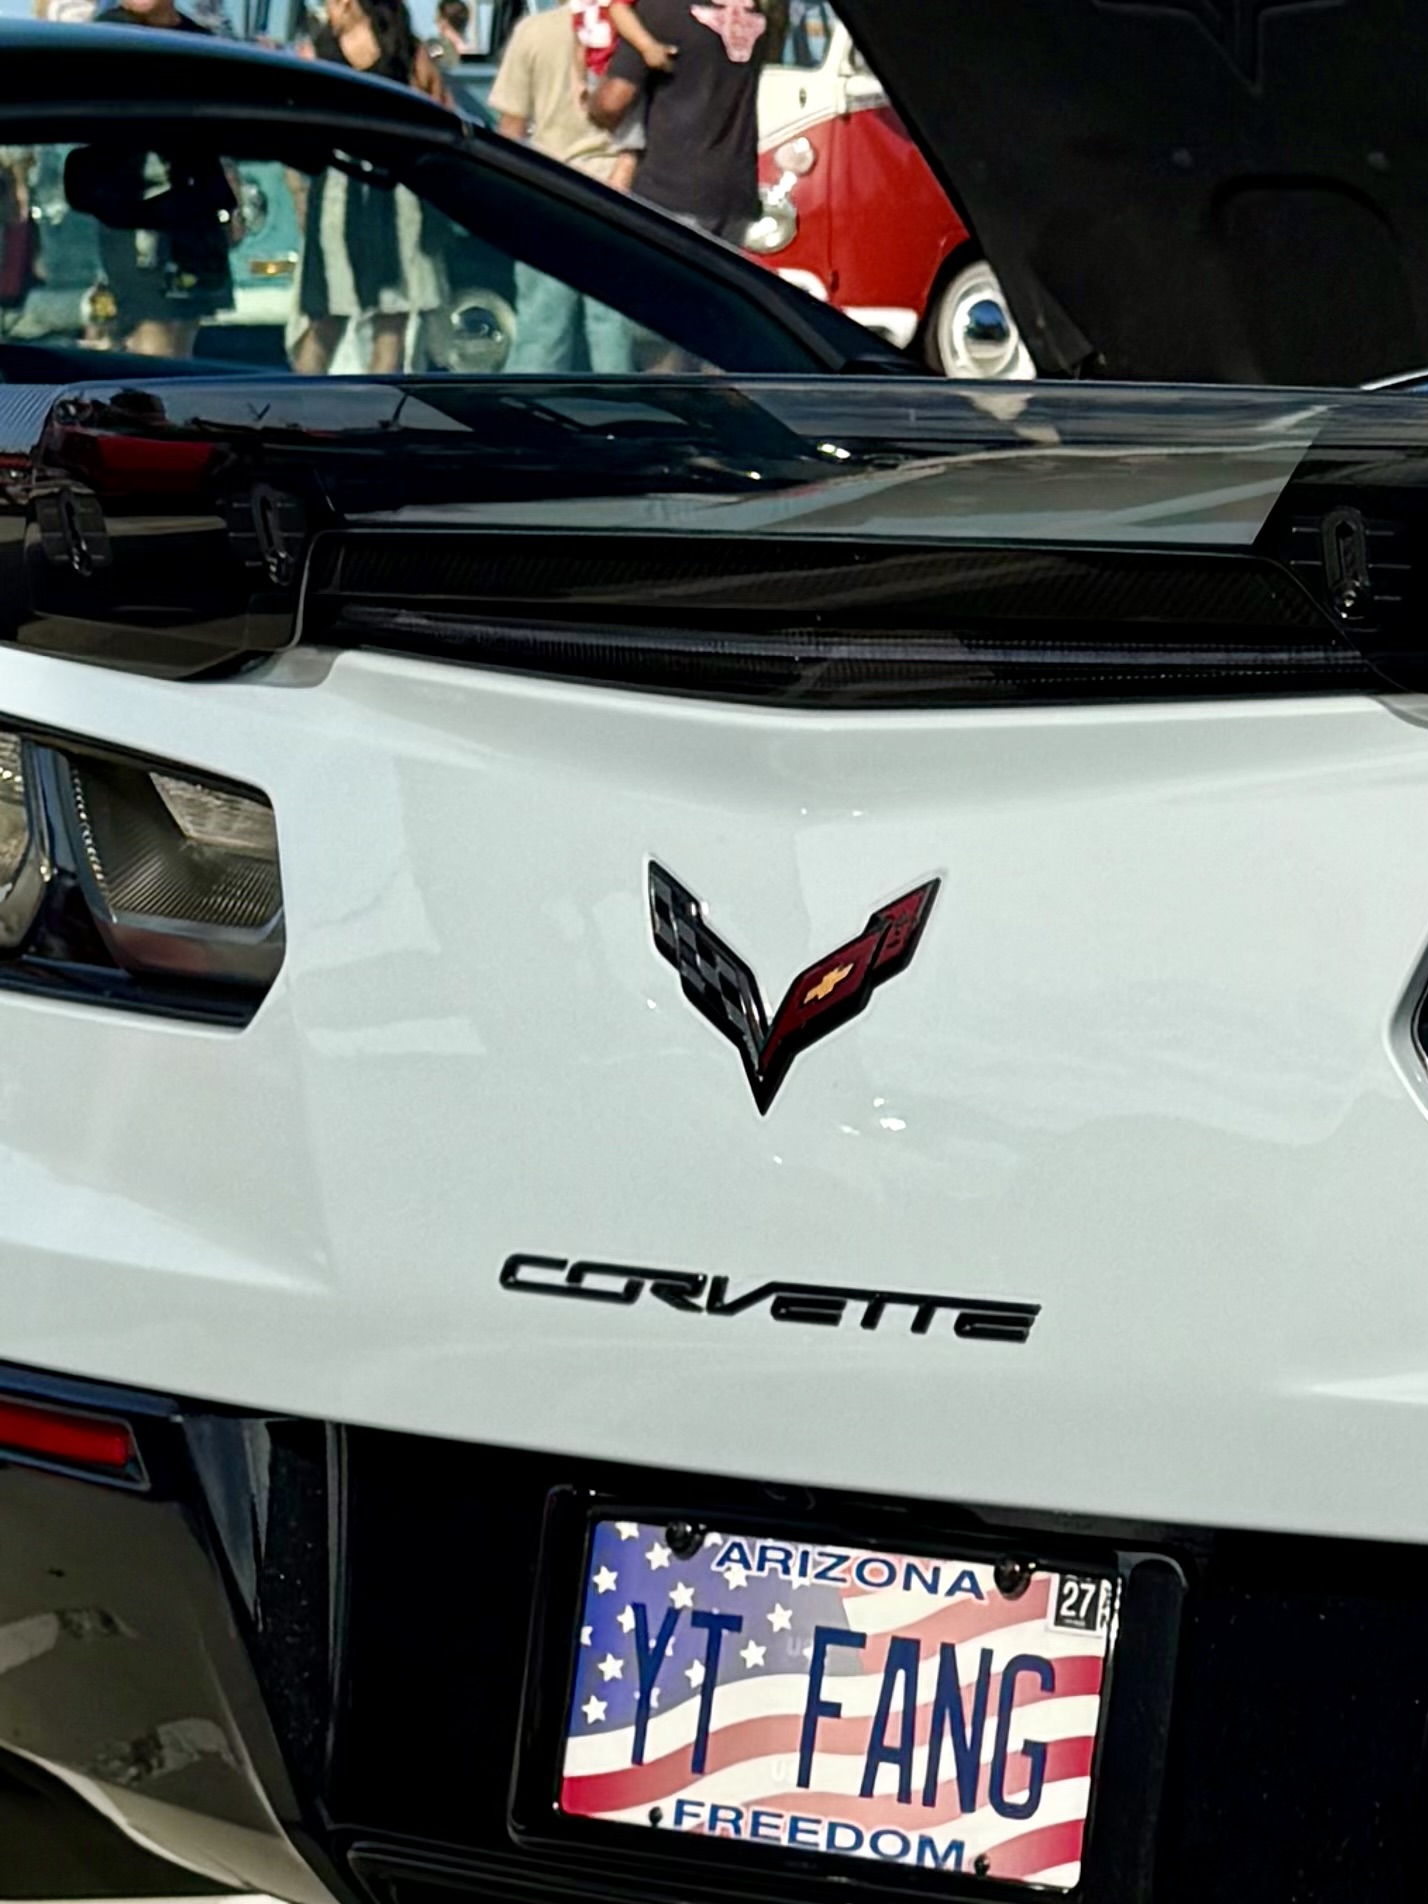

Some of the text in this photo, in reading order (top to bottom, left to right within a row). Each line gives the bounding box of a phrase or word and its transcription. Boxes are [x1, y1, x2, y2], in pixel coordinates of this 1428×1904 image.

[499, 1252, 1042, 1344] CORVETTE
[713, 1539, 986, 1602] ARIZONA
[1060, 1580, 1097, 1619] 27
[630, 1601, 1056, 1821] YT FANG
[673, 1799, 967, 1872] FREEDOM
